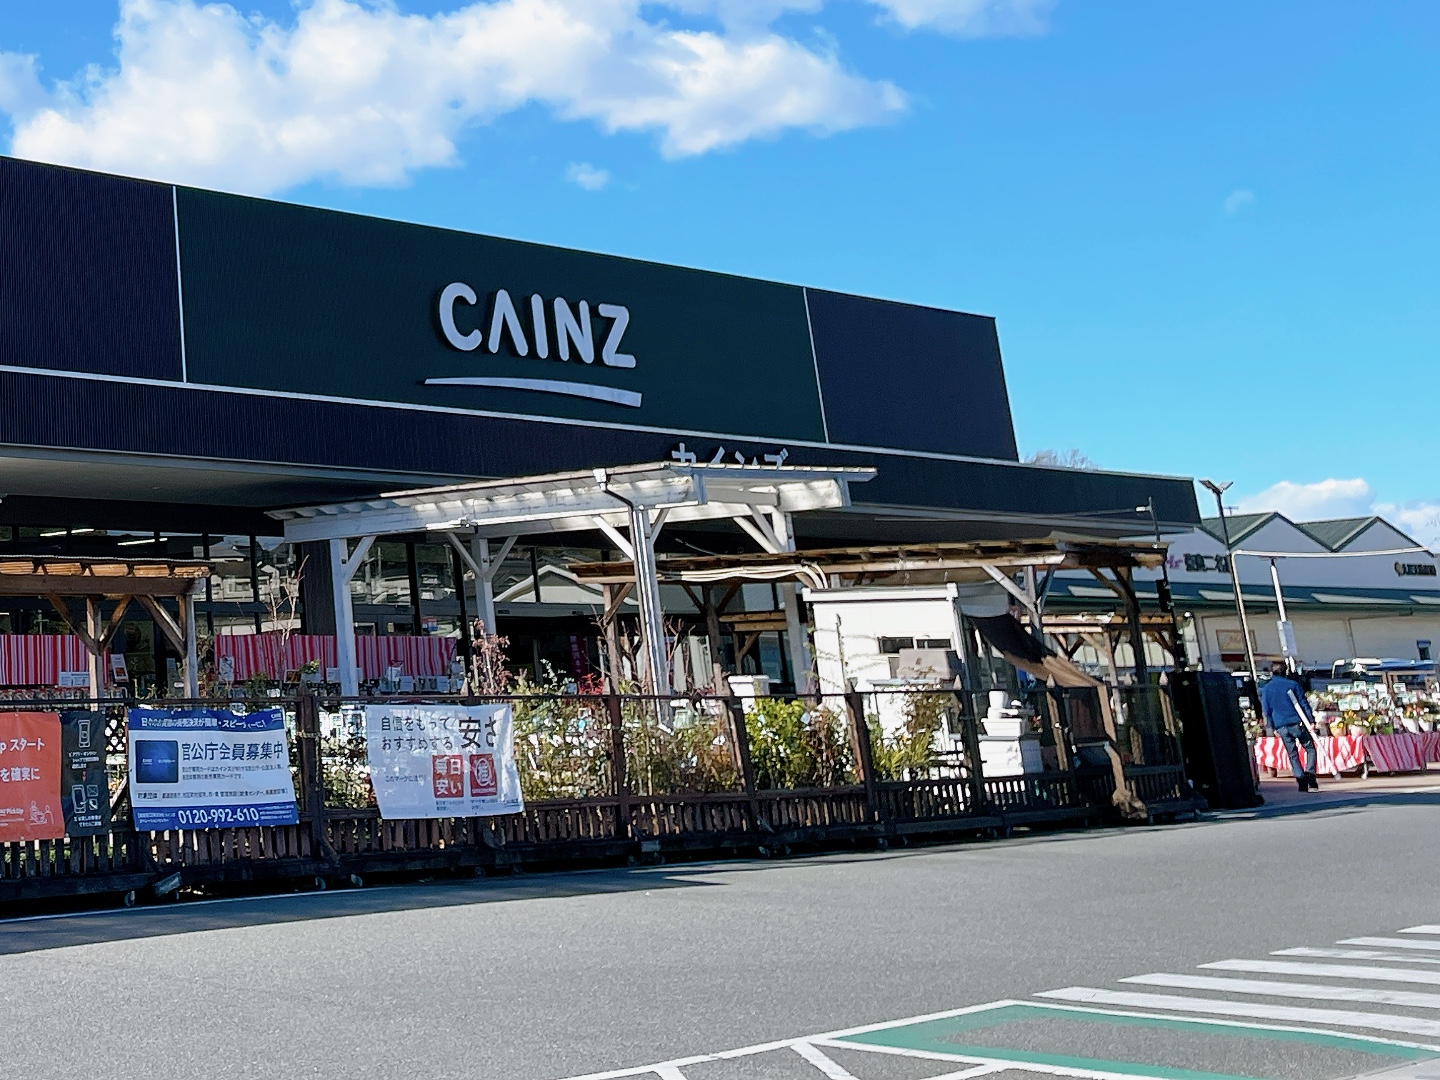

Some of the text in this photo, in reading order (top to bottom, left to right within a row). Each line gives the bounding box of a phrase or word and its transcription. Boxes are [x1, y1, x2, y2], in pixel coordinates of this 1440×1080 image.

[438, 282, 637, 368] CAINZ
[381, 716, 451, 732] 自信をもって
[9, 737, 45, 752] スタート
[182, 741, 284, 761] 官公庁会員募集中
[381, 736, 453, 751] おすすめする
[436, 779, 462, 796] 安い
[177, 807, 259, 824] 0120-992-610
